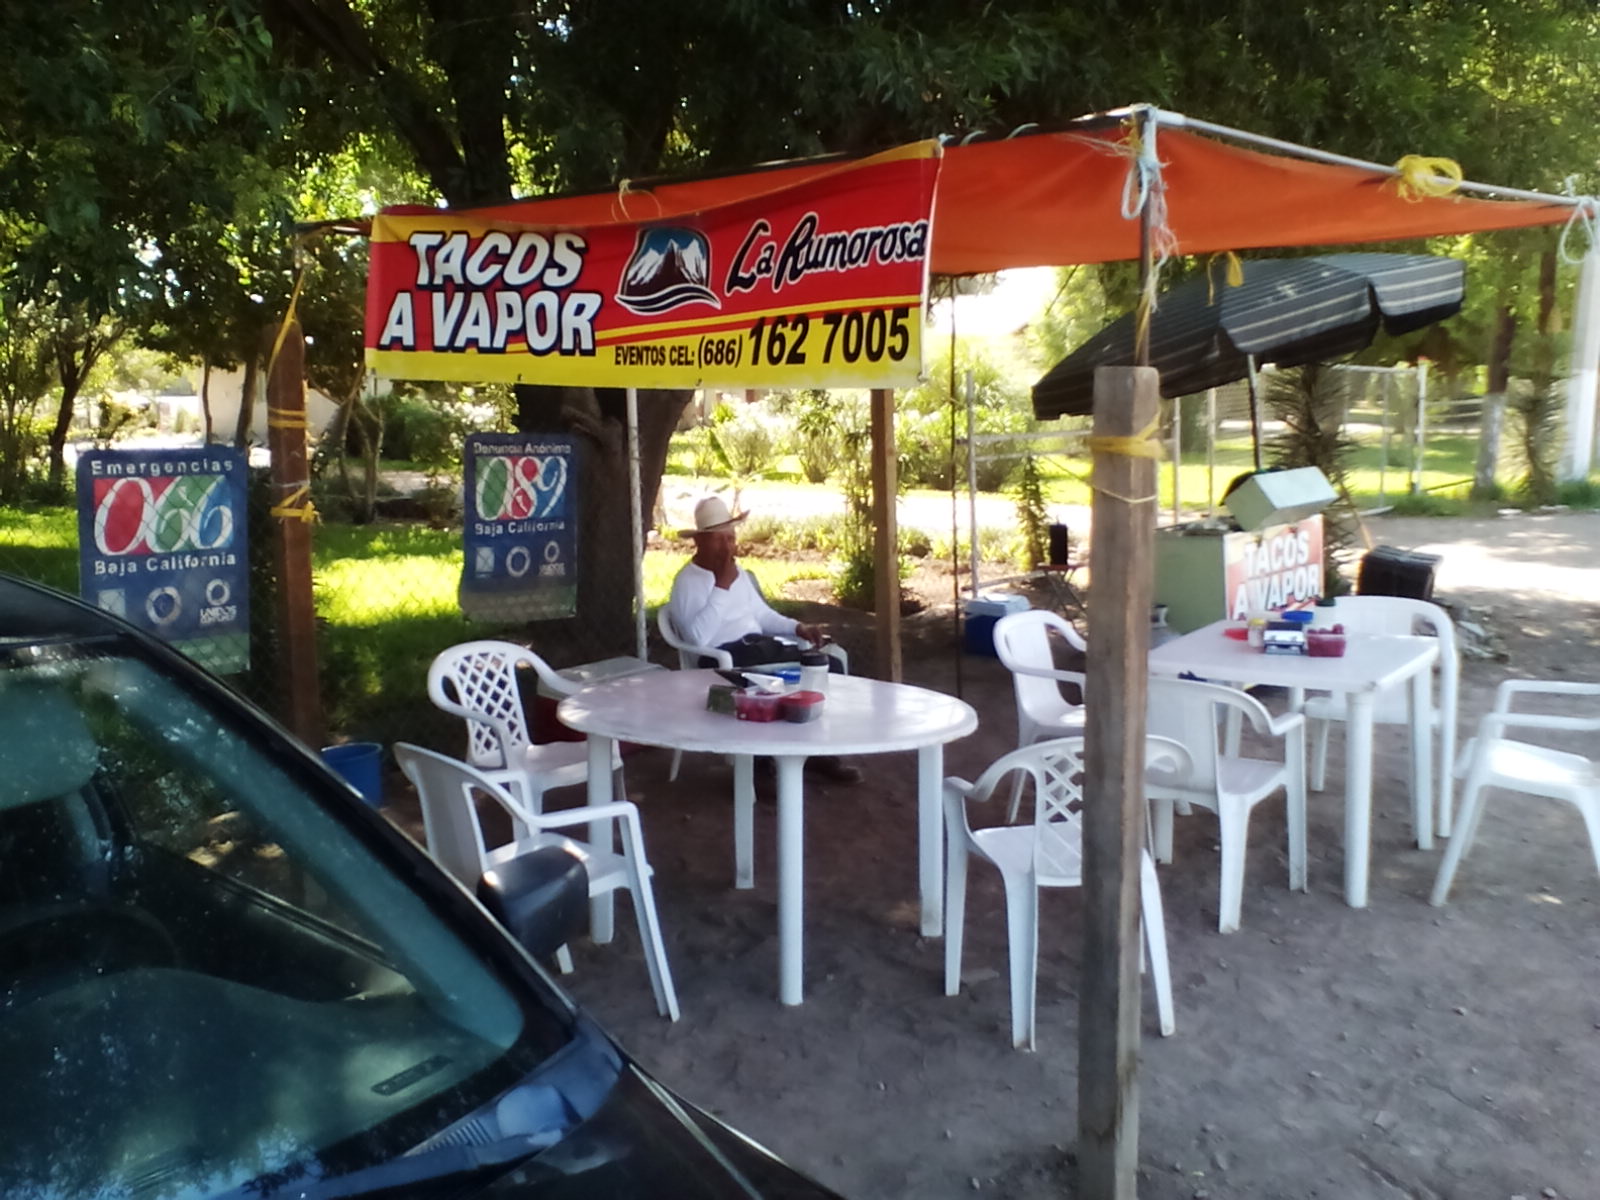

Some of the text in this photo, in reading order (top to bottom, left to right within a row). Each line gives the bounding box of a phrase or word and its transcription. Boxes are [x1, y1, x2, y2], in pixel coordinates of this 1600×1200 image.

[409, 232, 587, 288] TACOS
[724, 211, 929, 296] La Rumorosa
[379, 289, 602, 356] A VAPOR
[614, 308, 911, 368] EVENTOS CEL: (686) 162 7005
[91, 460, 233, 477] Emergencias
[476, 456, 568, 521] 089
[95, 475, 233, 556] 066
[475, 521, 565, 537] Baja California
[95, 553, 236, 576] Baja California
[1244, 530, 1310, 581] TACOS
[1233, 563, 1320, 621] A VAPOR
